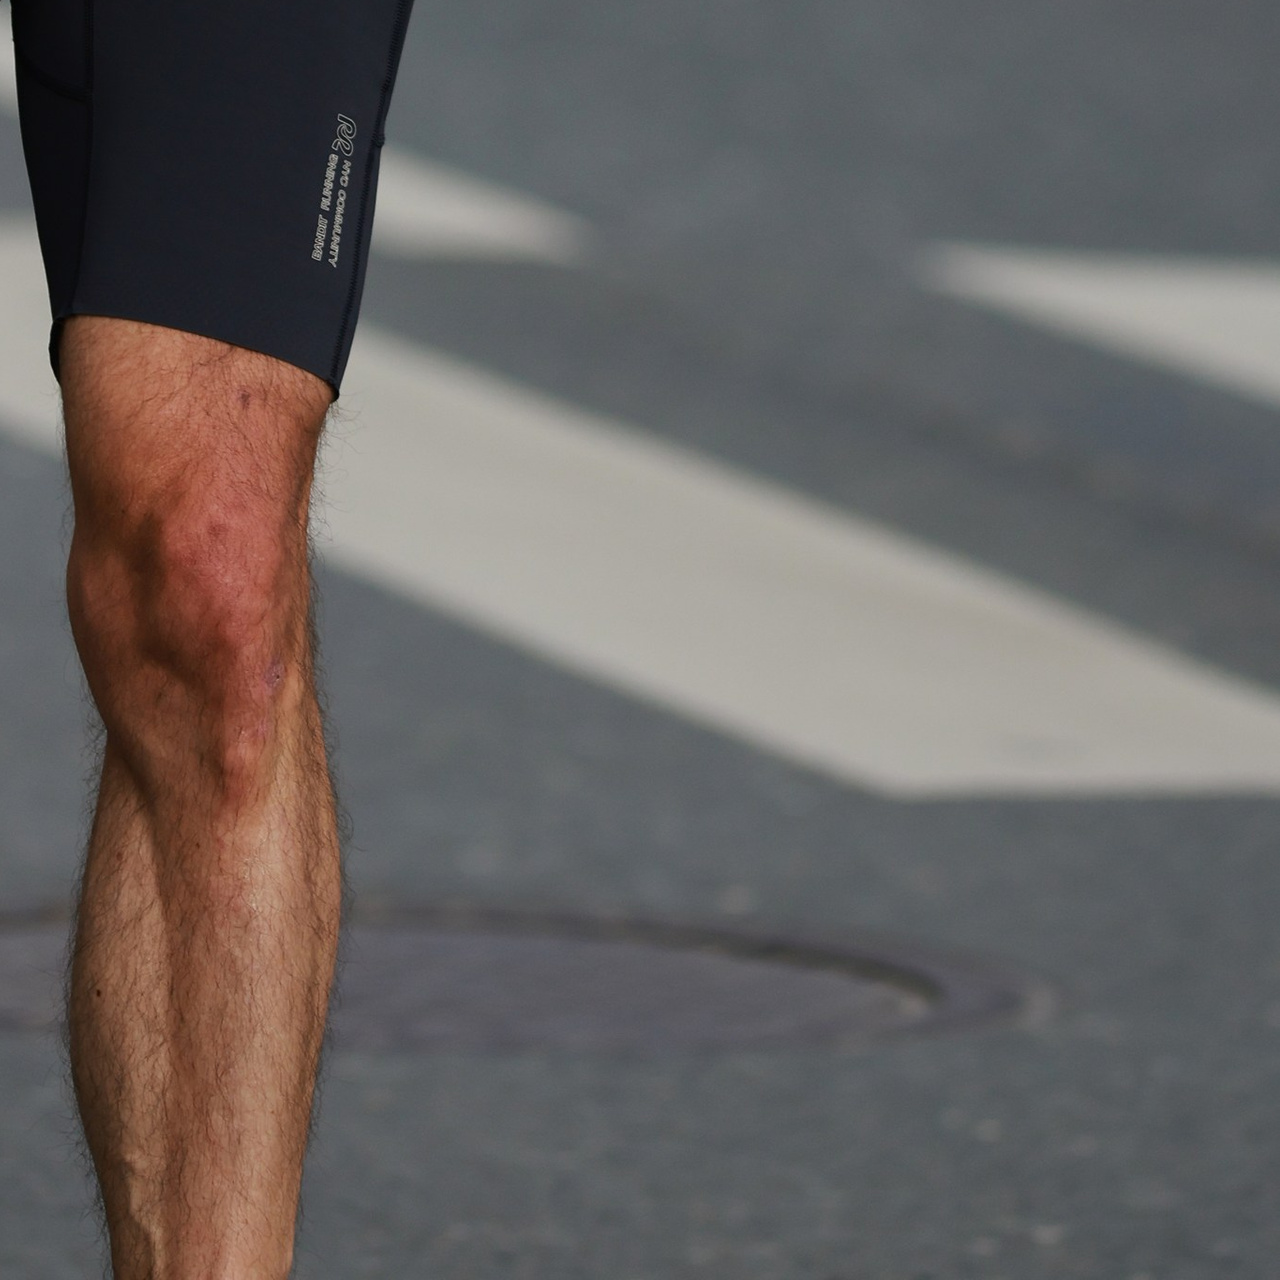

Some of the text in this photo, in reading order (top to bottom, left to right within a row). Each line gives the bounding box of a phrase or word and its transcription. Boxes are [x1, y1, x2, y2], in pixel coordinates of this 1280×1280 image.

[311, 153, 339, 262] BANDIT RUNNING
[328, 160, 351, 268] NYC COMMUNITY
